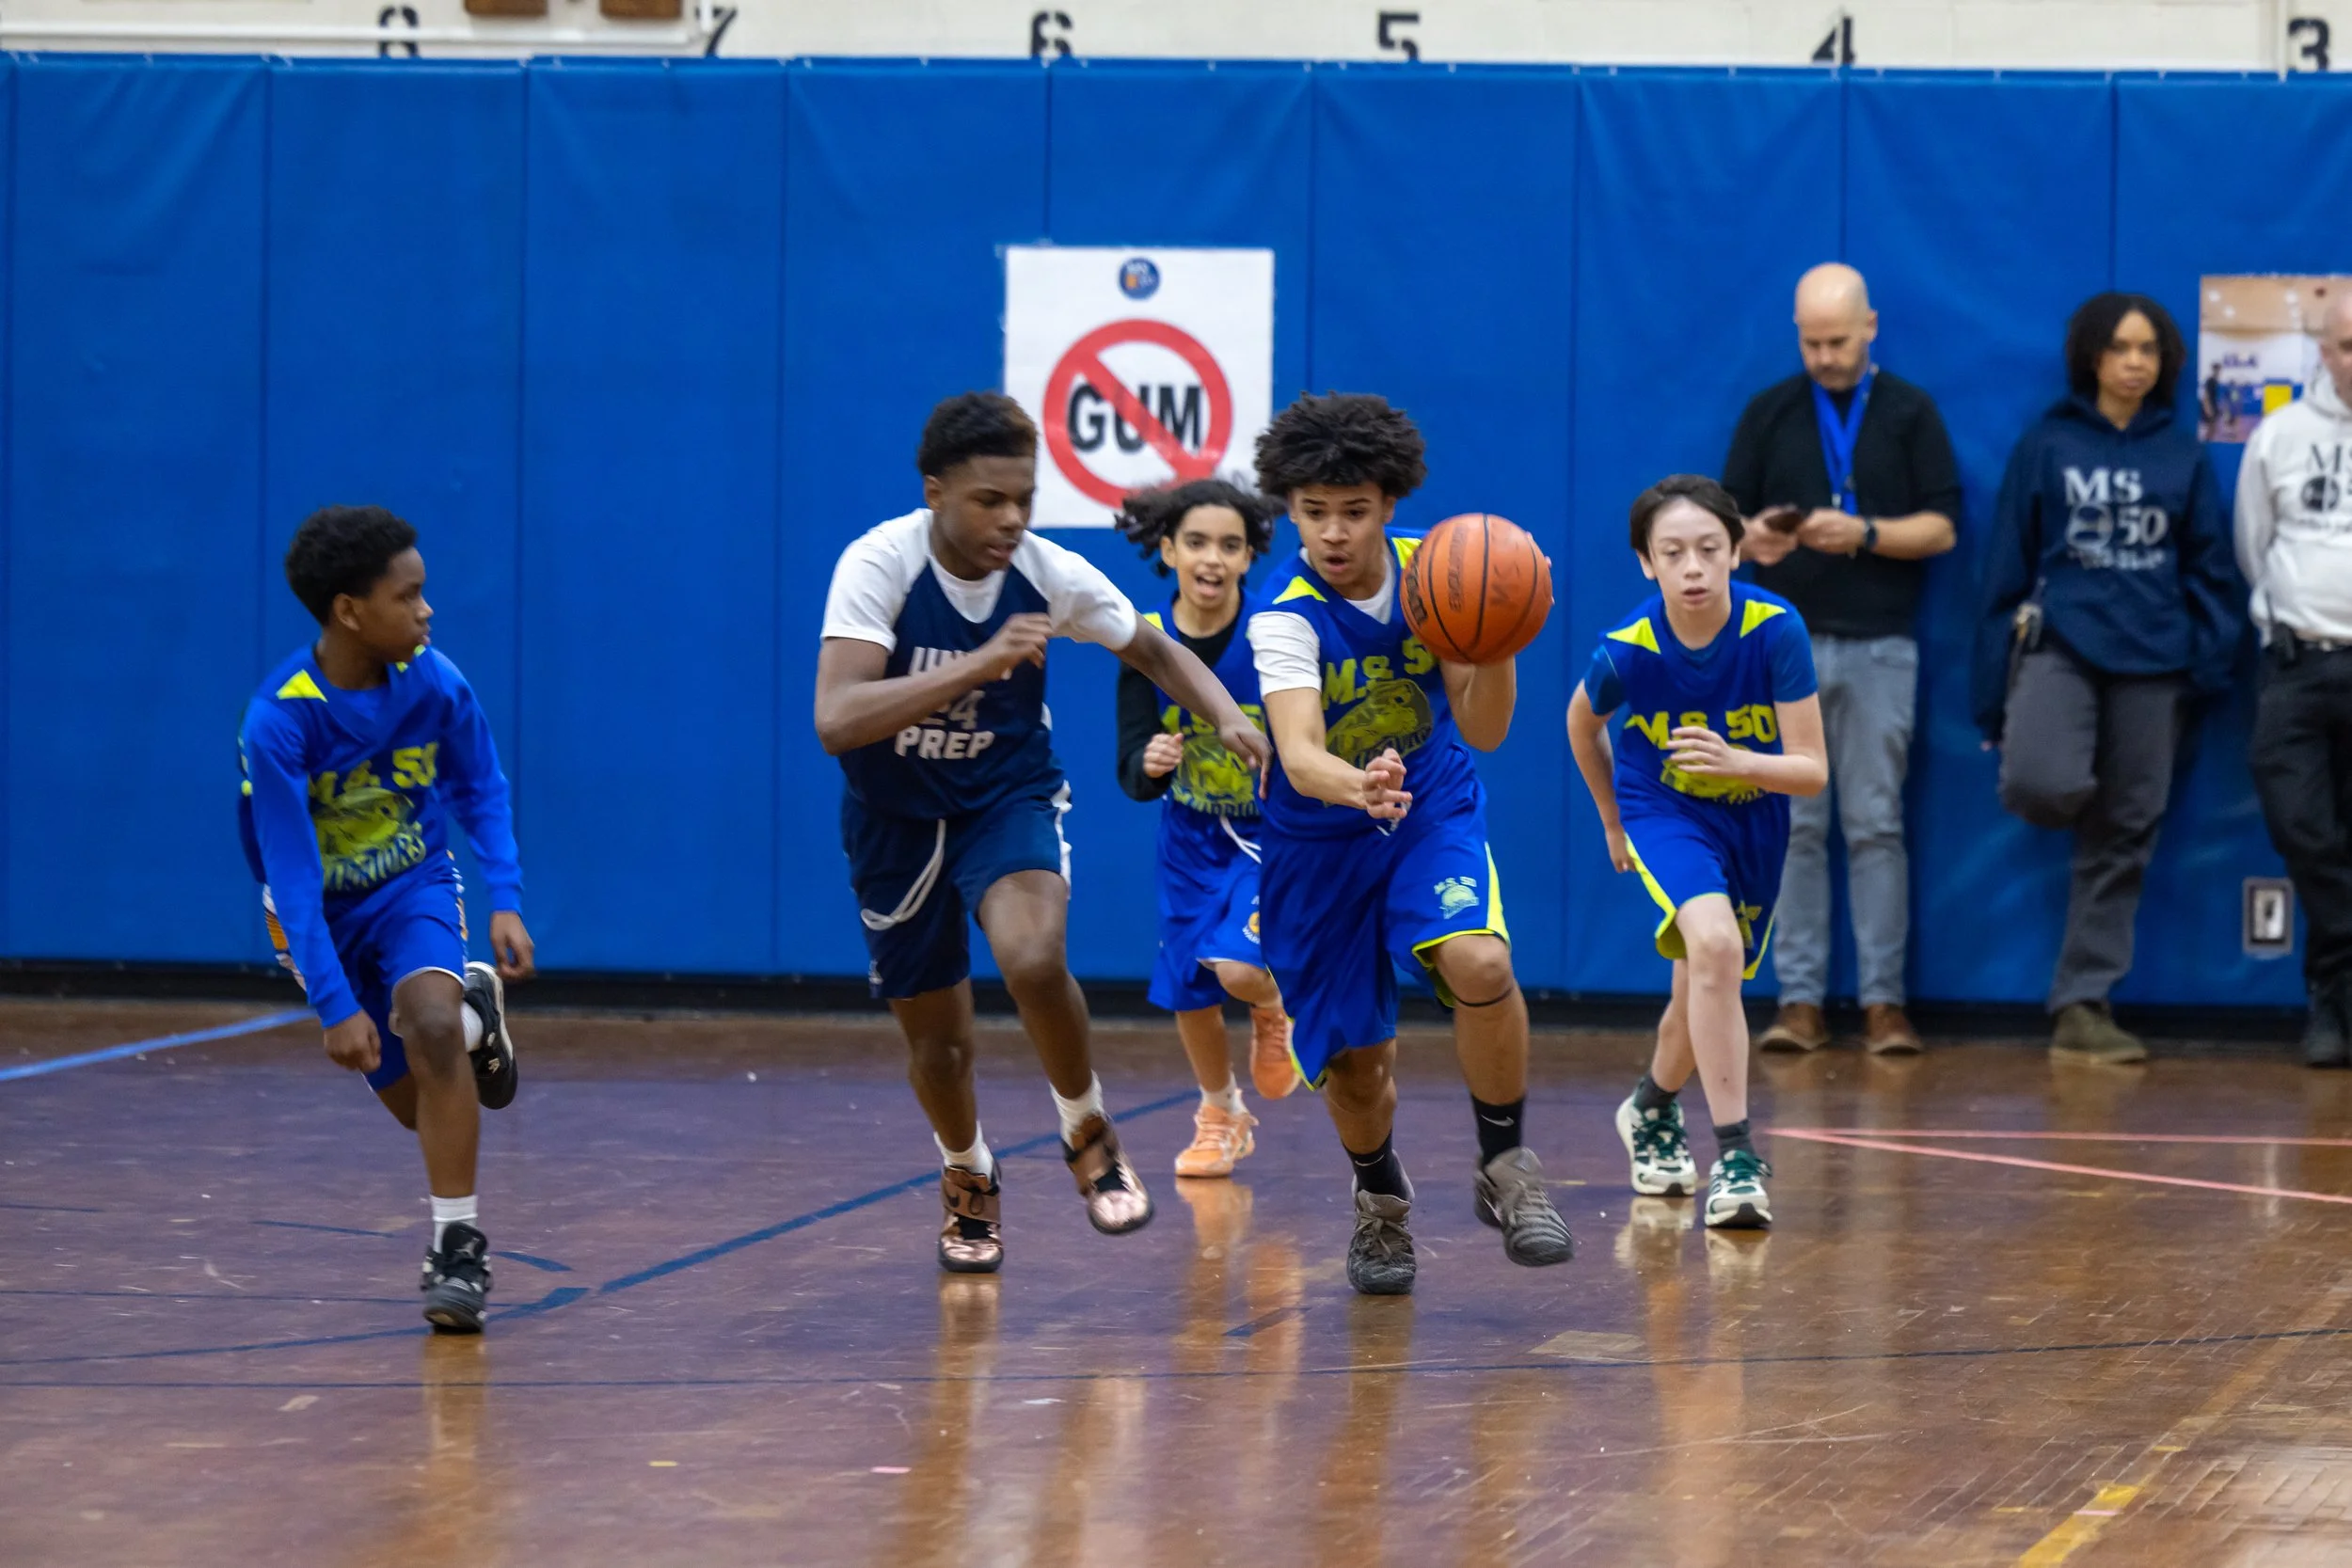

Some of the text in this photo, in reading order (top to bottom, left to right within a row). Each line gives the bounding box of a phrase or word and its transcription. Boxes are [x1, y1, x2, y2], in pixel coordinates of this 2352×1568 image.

[1031, 11, 1073, 59] 6
[1378, 11, 1420, 61] 5
[1812, 16, 1855, 65] 4
[2289, 17, 2329, 71] 3
[1067, 383, 1201, 454] GUM
[2064, 467, 2142, 505] MS
[2119, 506, 2168, 546] 50
[895, 725, 995, 760] PREP
[1725, 704, 1777, 743] 50
